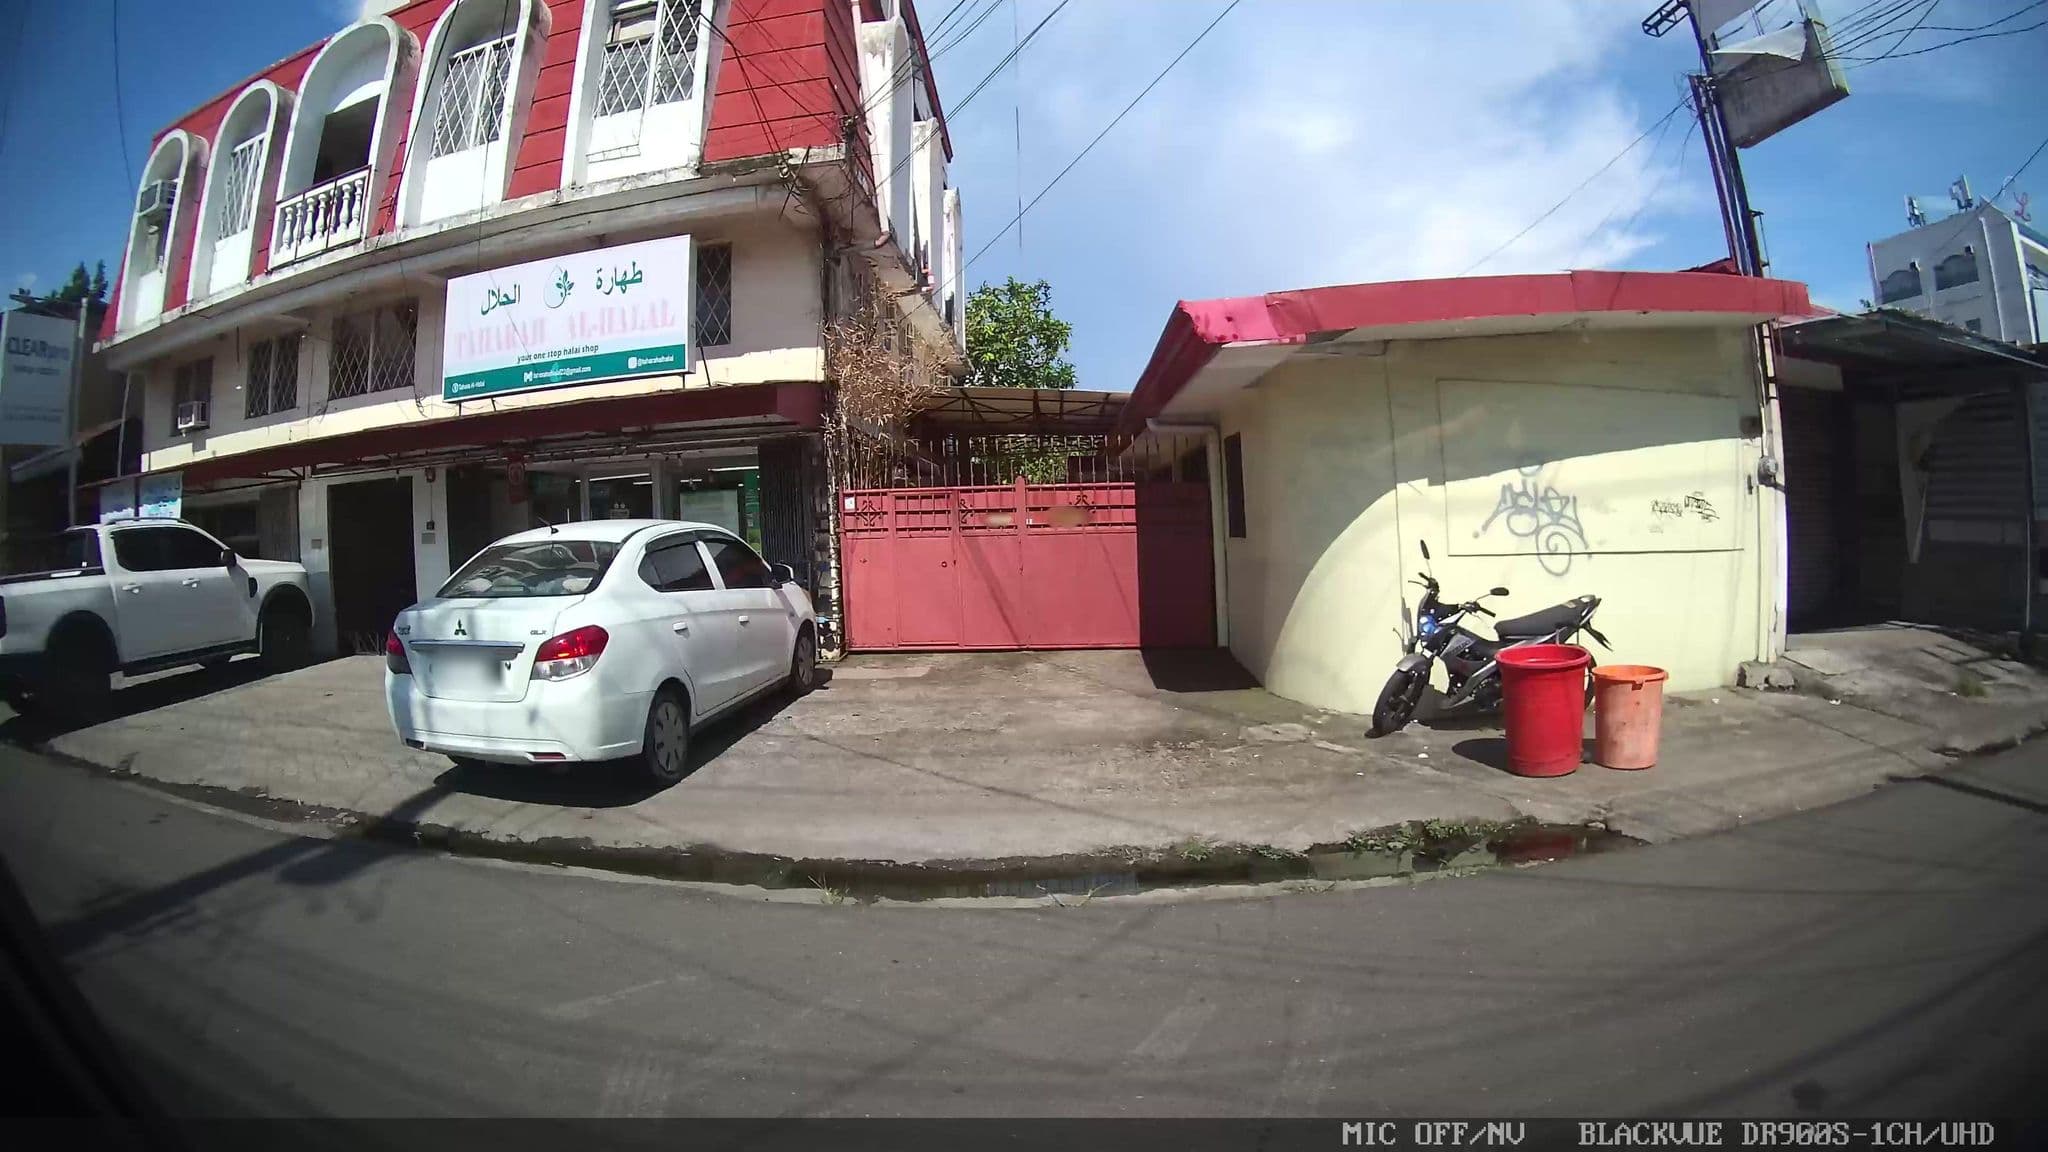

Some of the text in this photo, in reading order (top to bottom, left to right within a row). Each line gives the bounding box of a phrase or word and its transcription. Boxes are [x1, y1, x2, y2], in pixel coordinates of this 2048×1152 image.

[480, 261, 643, 315] طهارة الحلال
[517, 344, 599, 364] your one stop halal shop
